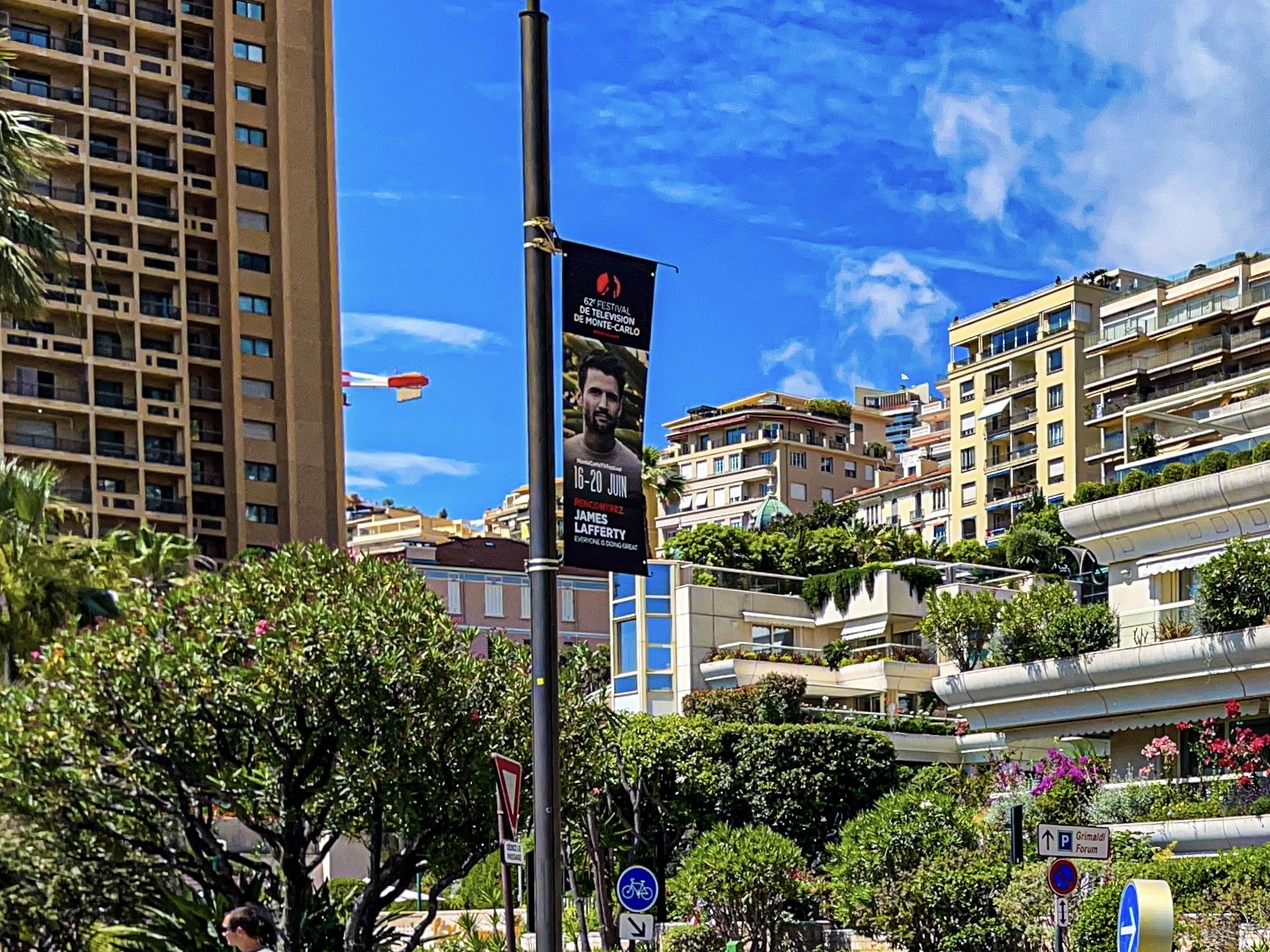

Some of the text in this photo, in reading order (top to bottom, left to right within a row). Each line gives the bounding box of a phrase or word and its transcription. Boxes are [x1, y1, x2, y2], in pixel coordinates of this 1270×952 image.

[579, 305, 591, 316] DE
[597, 300, 631, 315] FESTIVAL
[573, 313, 584, 324] DE
[586, 317, 640, 336] MONTE-CARLO
[574, 465, 627, 498] 16-20 JUIN
[574, 498, 624, 514] RENCONTREZ
[574, 509, 608, 525] JAMES
[574, 521, 626, 541] LAFFERTY
[574, 535, 600, 546] EVERYONE
[605, 540, 621, 549] DOING
[622, 543, 638, 551] GREAT
[1061, 834, 1070, 847] P
[1076, 831, 1106, 842] Grimaldi
[1075, 843, 1098, 854] Forum
